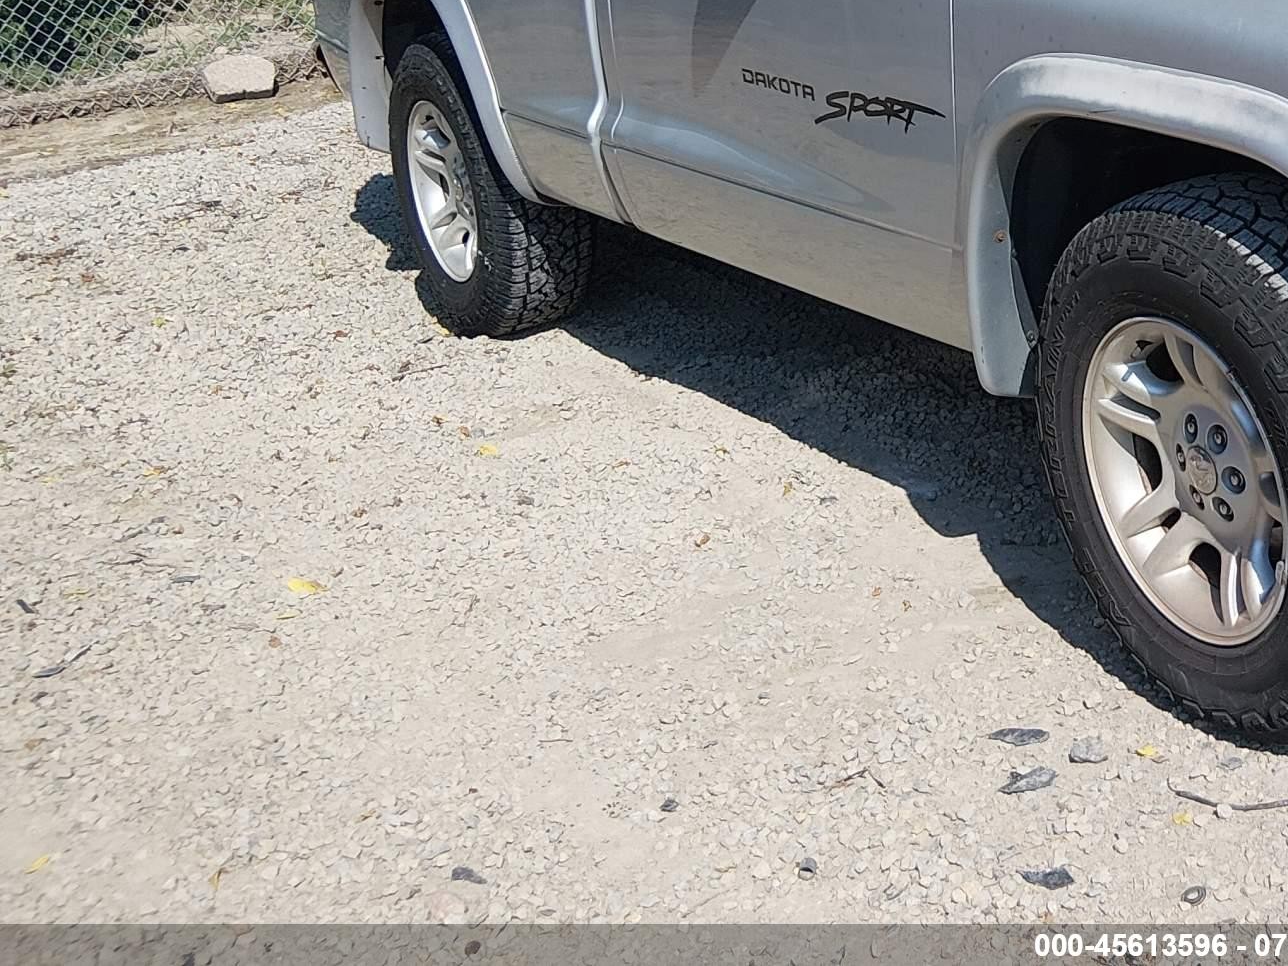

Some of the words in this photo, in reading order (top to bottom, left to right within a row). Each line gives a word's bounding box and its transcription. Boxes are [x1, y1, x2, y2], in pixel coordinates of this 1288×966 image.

[741, 68, 816, 102] DAKOTA
[814, 90, 947, 134] SPORT
[1042, 324, 1077, 531] TERRAIN
